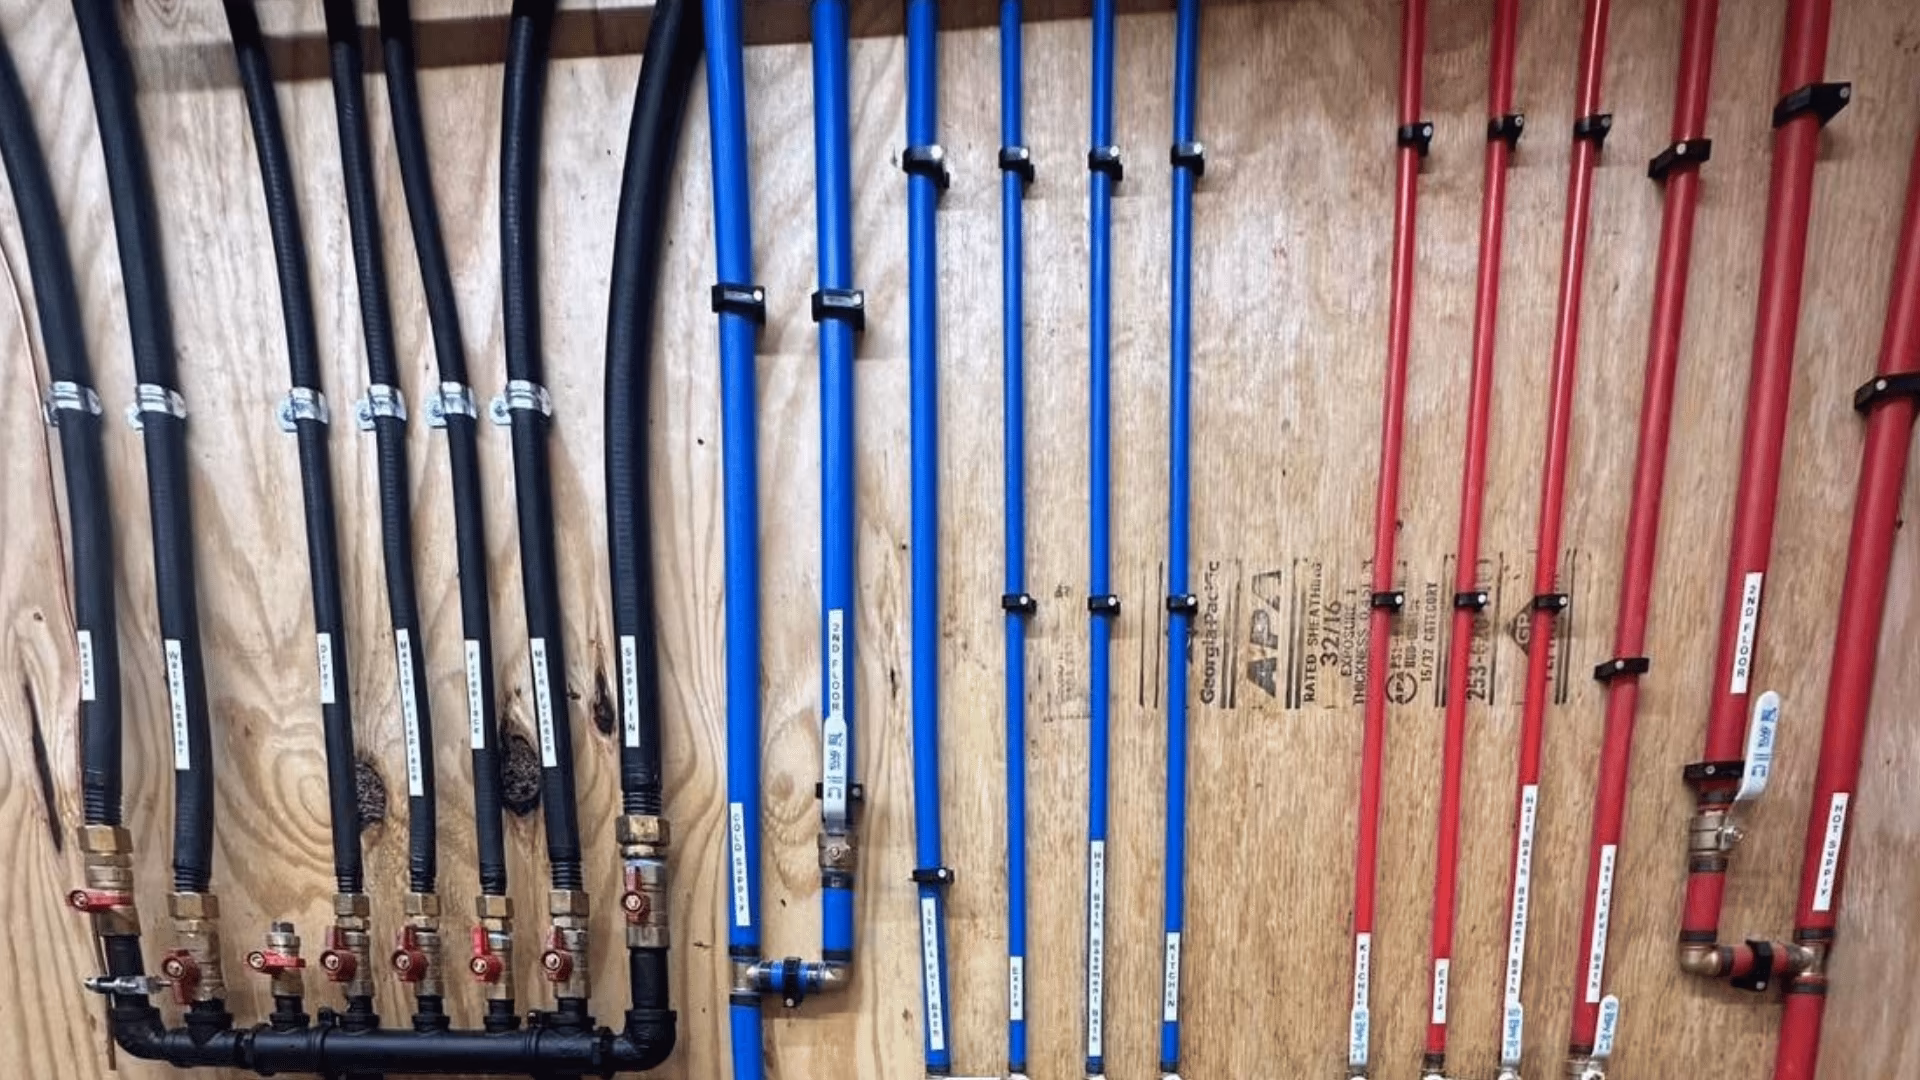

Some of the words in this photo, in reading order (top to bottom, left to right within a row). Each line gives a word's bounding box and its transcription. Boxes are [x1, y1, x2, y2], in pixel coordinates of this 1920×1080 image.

[1423, 581, 1437, 642] CATEGORY
[1745, 584, 1756, 617] 2ND
[832, 622, 841, 654] 2ND
[1247, 569, 1281, 698] APA
[1319, 601, 1341, 667] 32/16
[1340, 603, 1357, 677] EXPOSURE
[1515, 613, 1530, 645] GP
[1736, 622, 1750, 678] FLOOR
[168, 651, 180, 696] Water
[320, 644, 329, 689] Dryer
[400, 641, 410, 692] Master
[534, 650, 545, 686] Main
[625, 647, 634, 707] Supply
[832, 659, 841, 711] FLOOR
[1304, 653, 1317, 702] RATED
[1353, 627, 1368, 706] THICKNESS
[1421, 648, 1434, 683] 15/32
[469, 651, 480, 734] Fireplace
[1394, 671, 1404, 706] APA
[733, 813, 742, 852] COLD
[1525, 796, 1534, 832] Half
[1832, 804, 1843, 833] HOT
[1093, 852, 1102, 887] Half
[1520, 839, 1530, 876] Bath
[1514, 886, 1525, 954] Basement
[1167, 943, 1176, 1008] KITCHEN
[1436, 969, 1446, 1010] Extra
[1509, 958, 1519, 994] Bath
[1591, 953, 1601, 989] Bath
[931, 1002, 940, 1037] Bath
